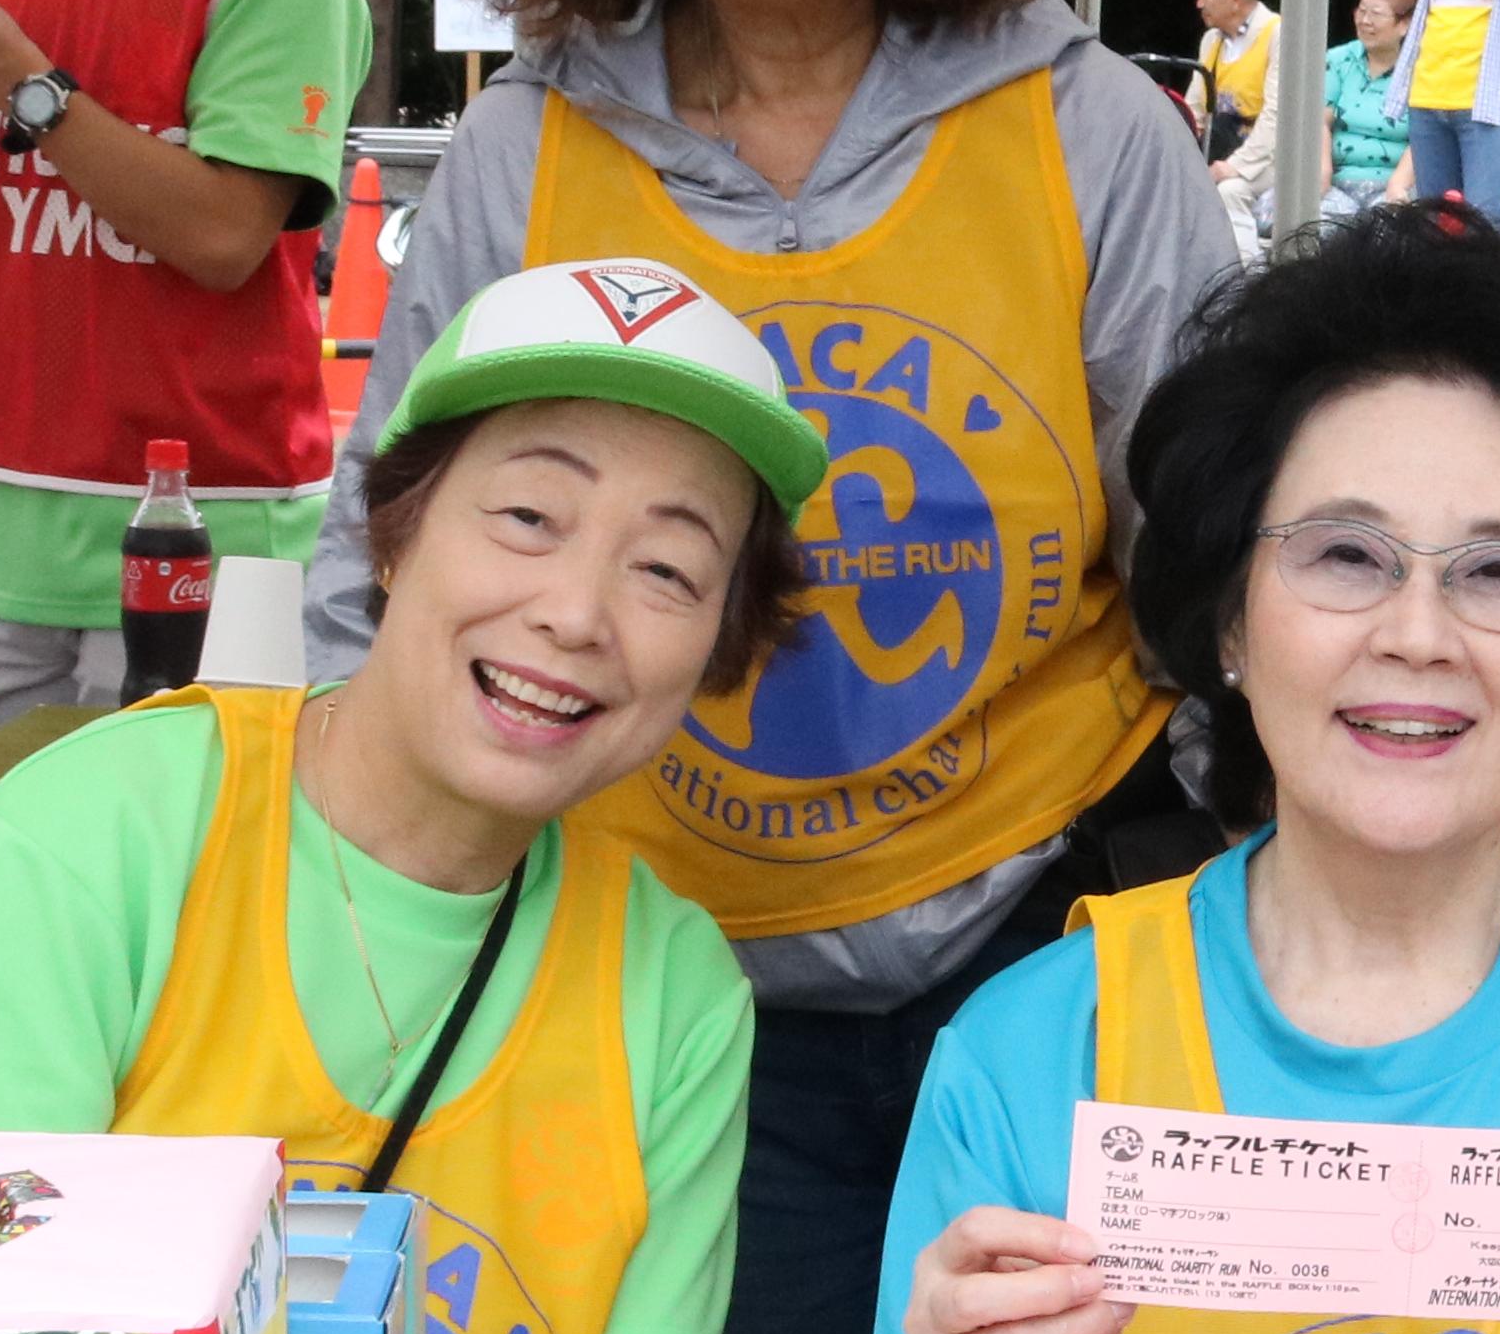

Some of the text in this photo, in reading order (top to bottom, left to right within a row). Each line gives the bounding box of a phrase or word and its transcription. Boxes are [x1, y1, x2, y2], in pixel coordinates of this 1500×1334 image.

[810, 539, 993, 580] THE RUN
[1022, 527, 1065, 644] run
[1163, 1129, 1369, 1158] ラッフルチケット
[1151, 1150, 1391, 1183] RAFFLE TICKET
[1106, 1185, 1144, 1201] TEAM
[1100, 1216, 1142, 1232] NAME
[1443, 1212, 1482, 1229] No.
[1218, 1263, 1242, 1277] RUN
[1291, 1263, 1331, 1278] 0036
